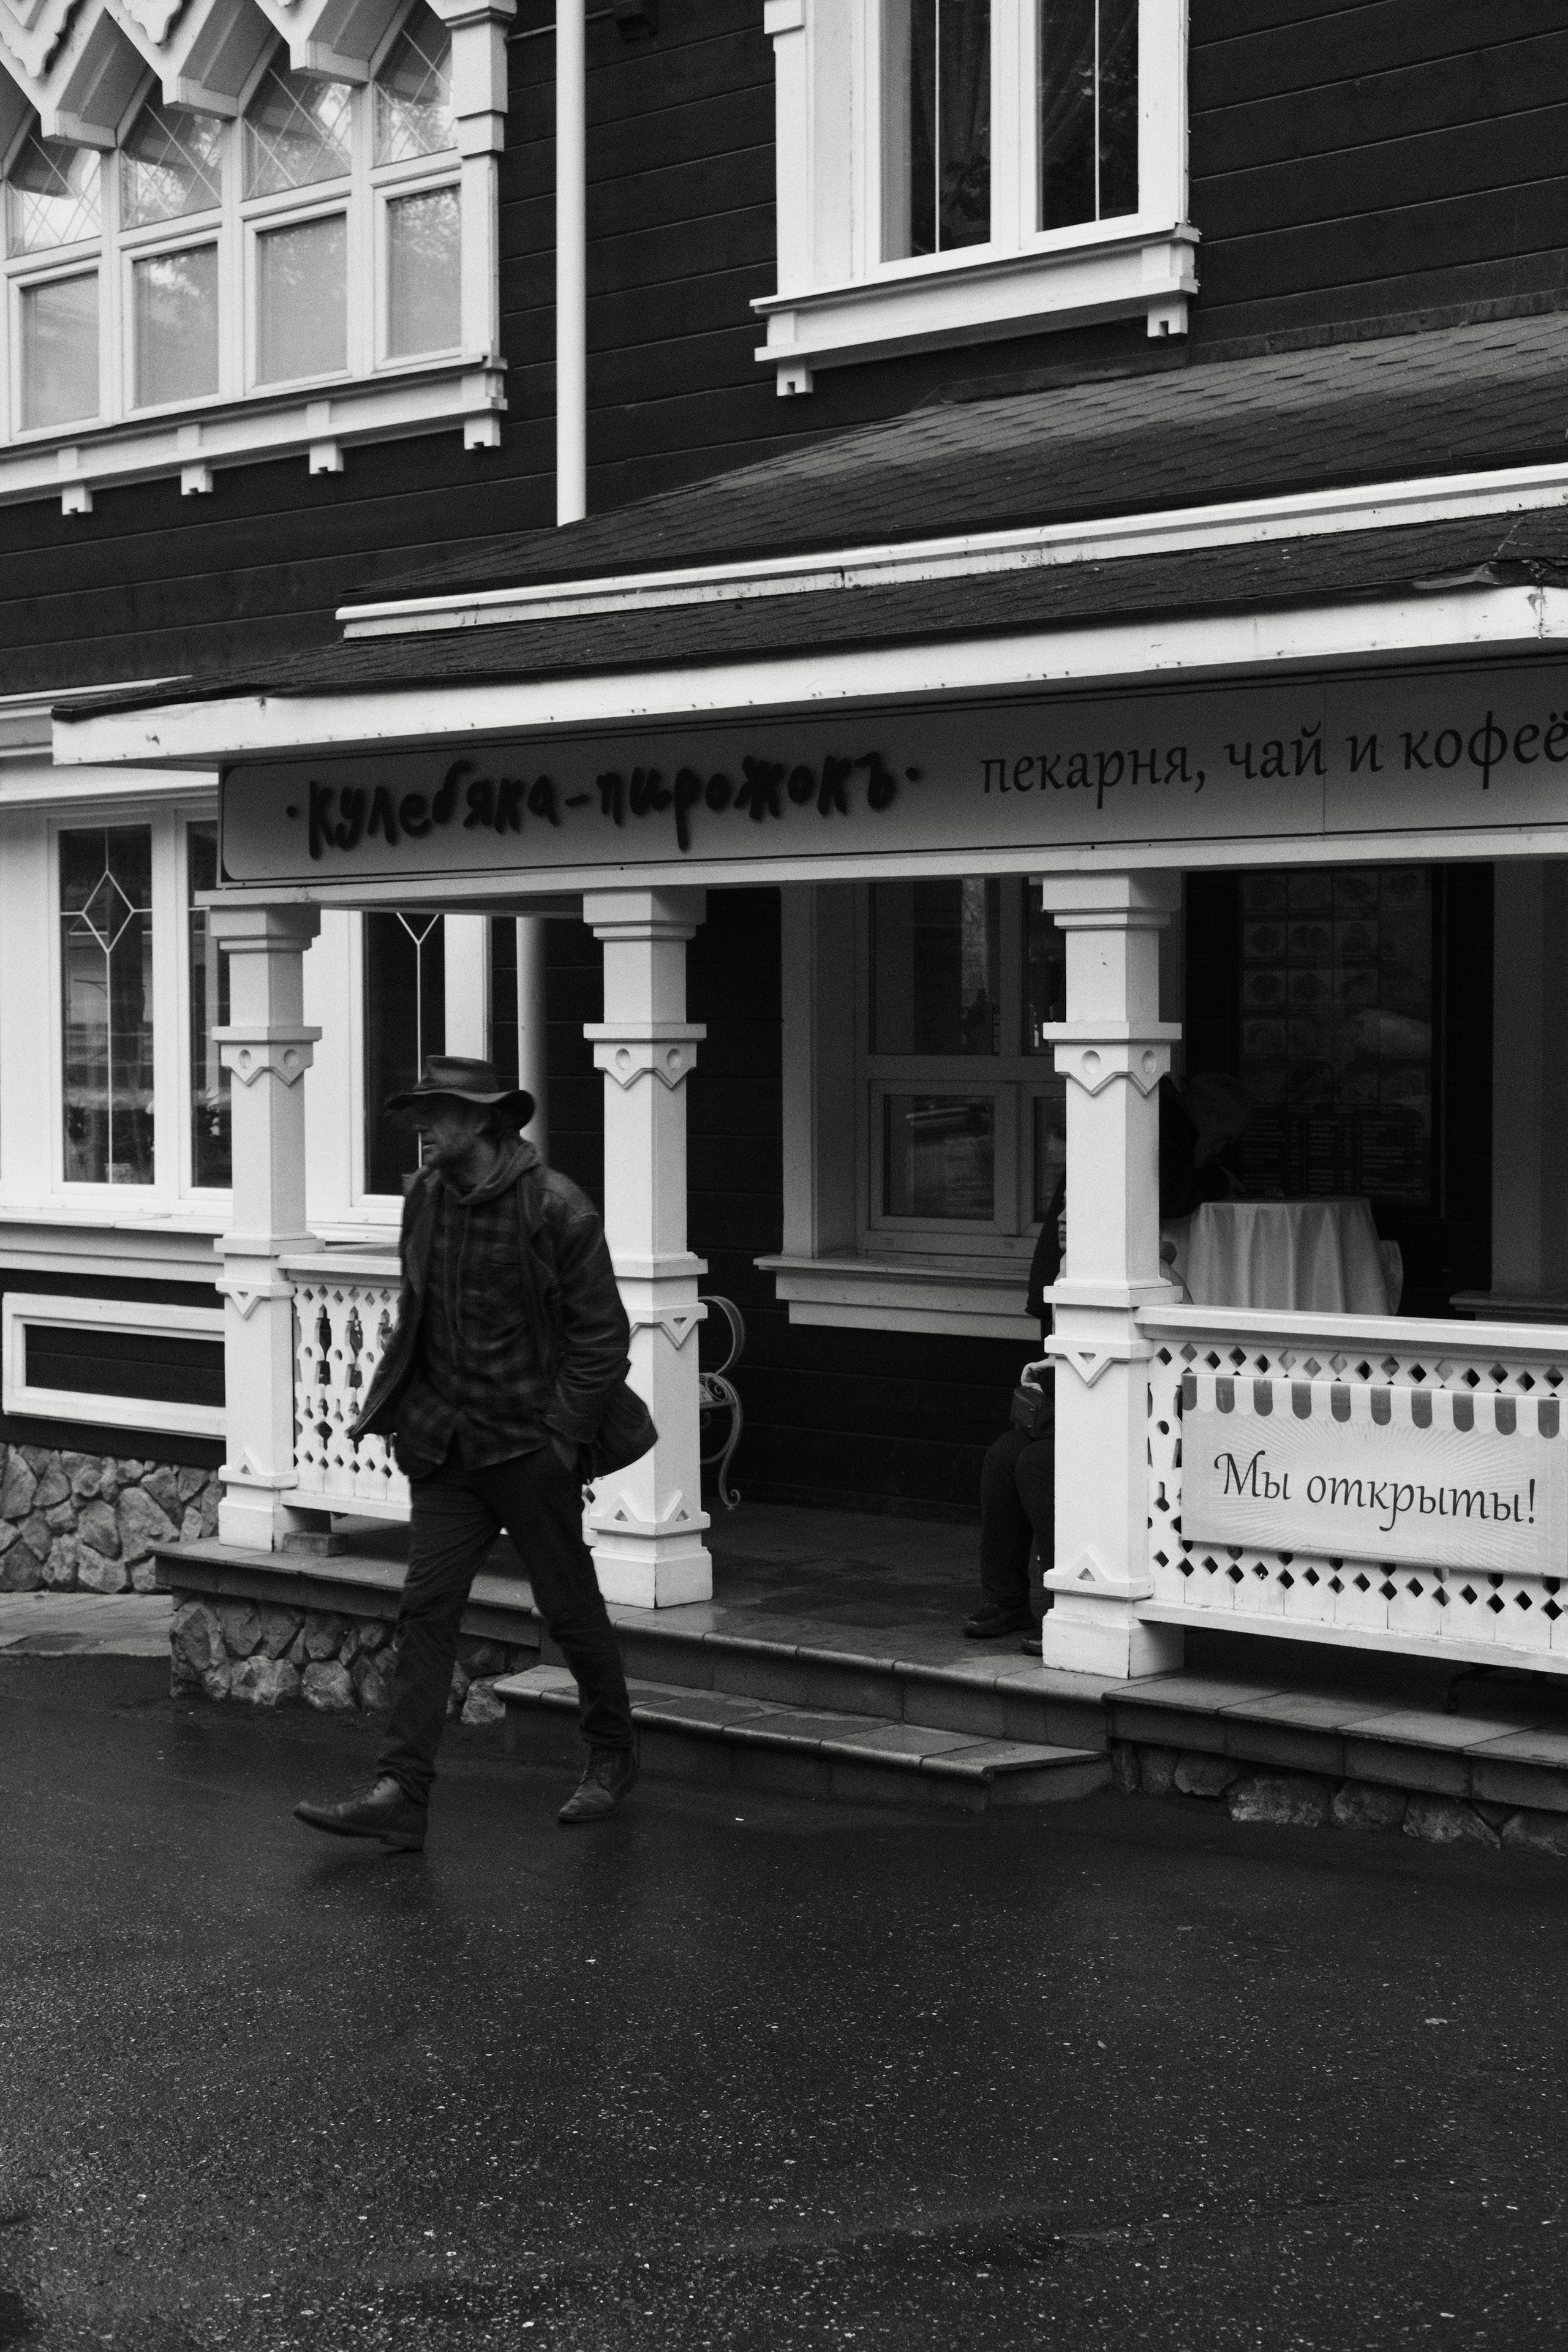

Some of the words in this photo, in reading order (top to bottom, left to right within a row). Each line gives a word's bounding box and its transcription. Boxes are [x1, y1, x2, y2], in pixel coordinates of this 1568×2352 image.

[980, 745, 1206, 810] пекарня,
[1223, 721, 1328, 780] чай
[1345, 734, 1384, 774] и
[1213, 1450, 1291, 1501] Мы
[1306, 1475, 1536, 1532] открыты!
